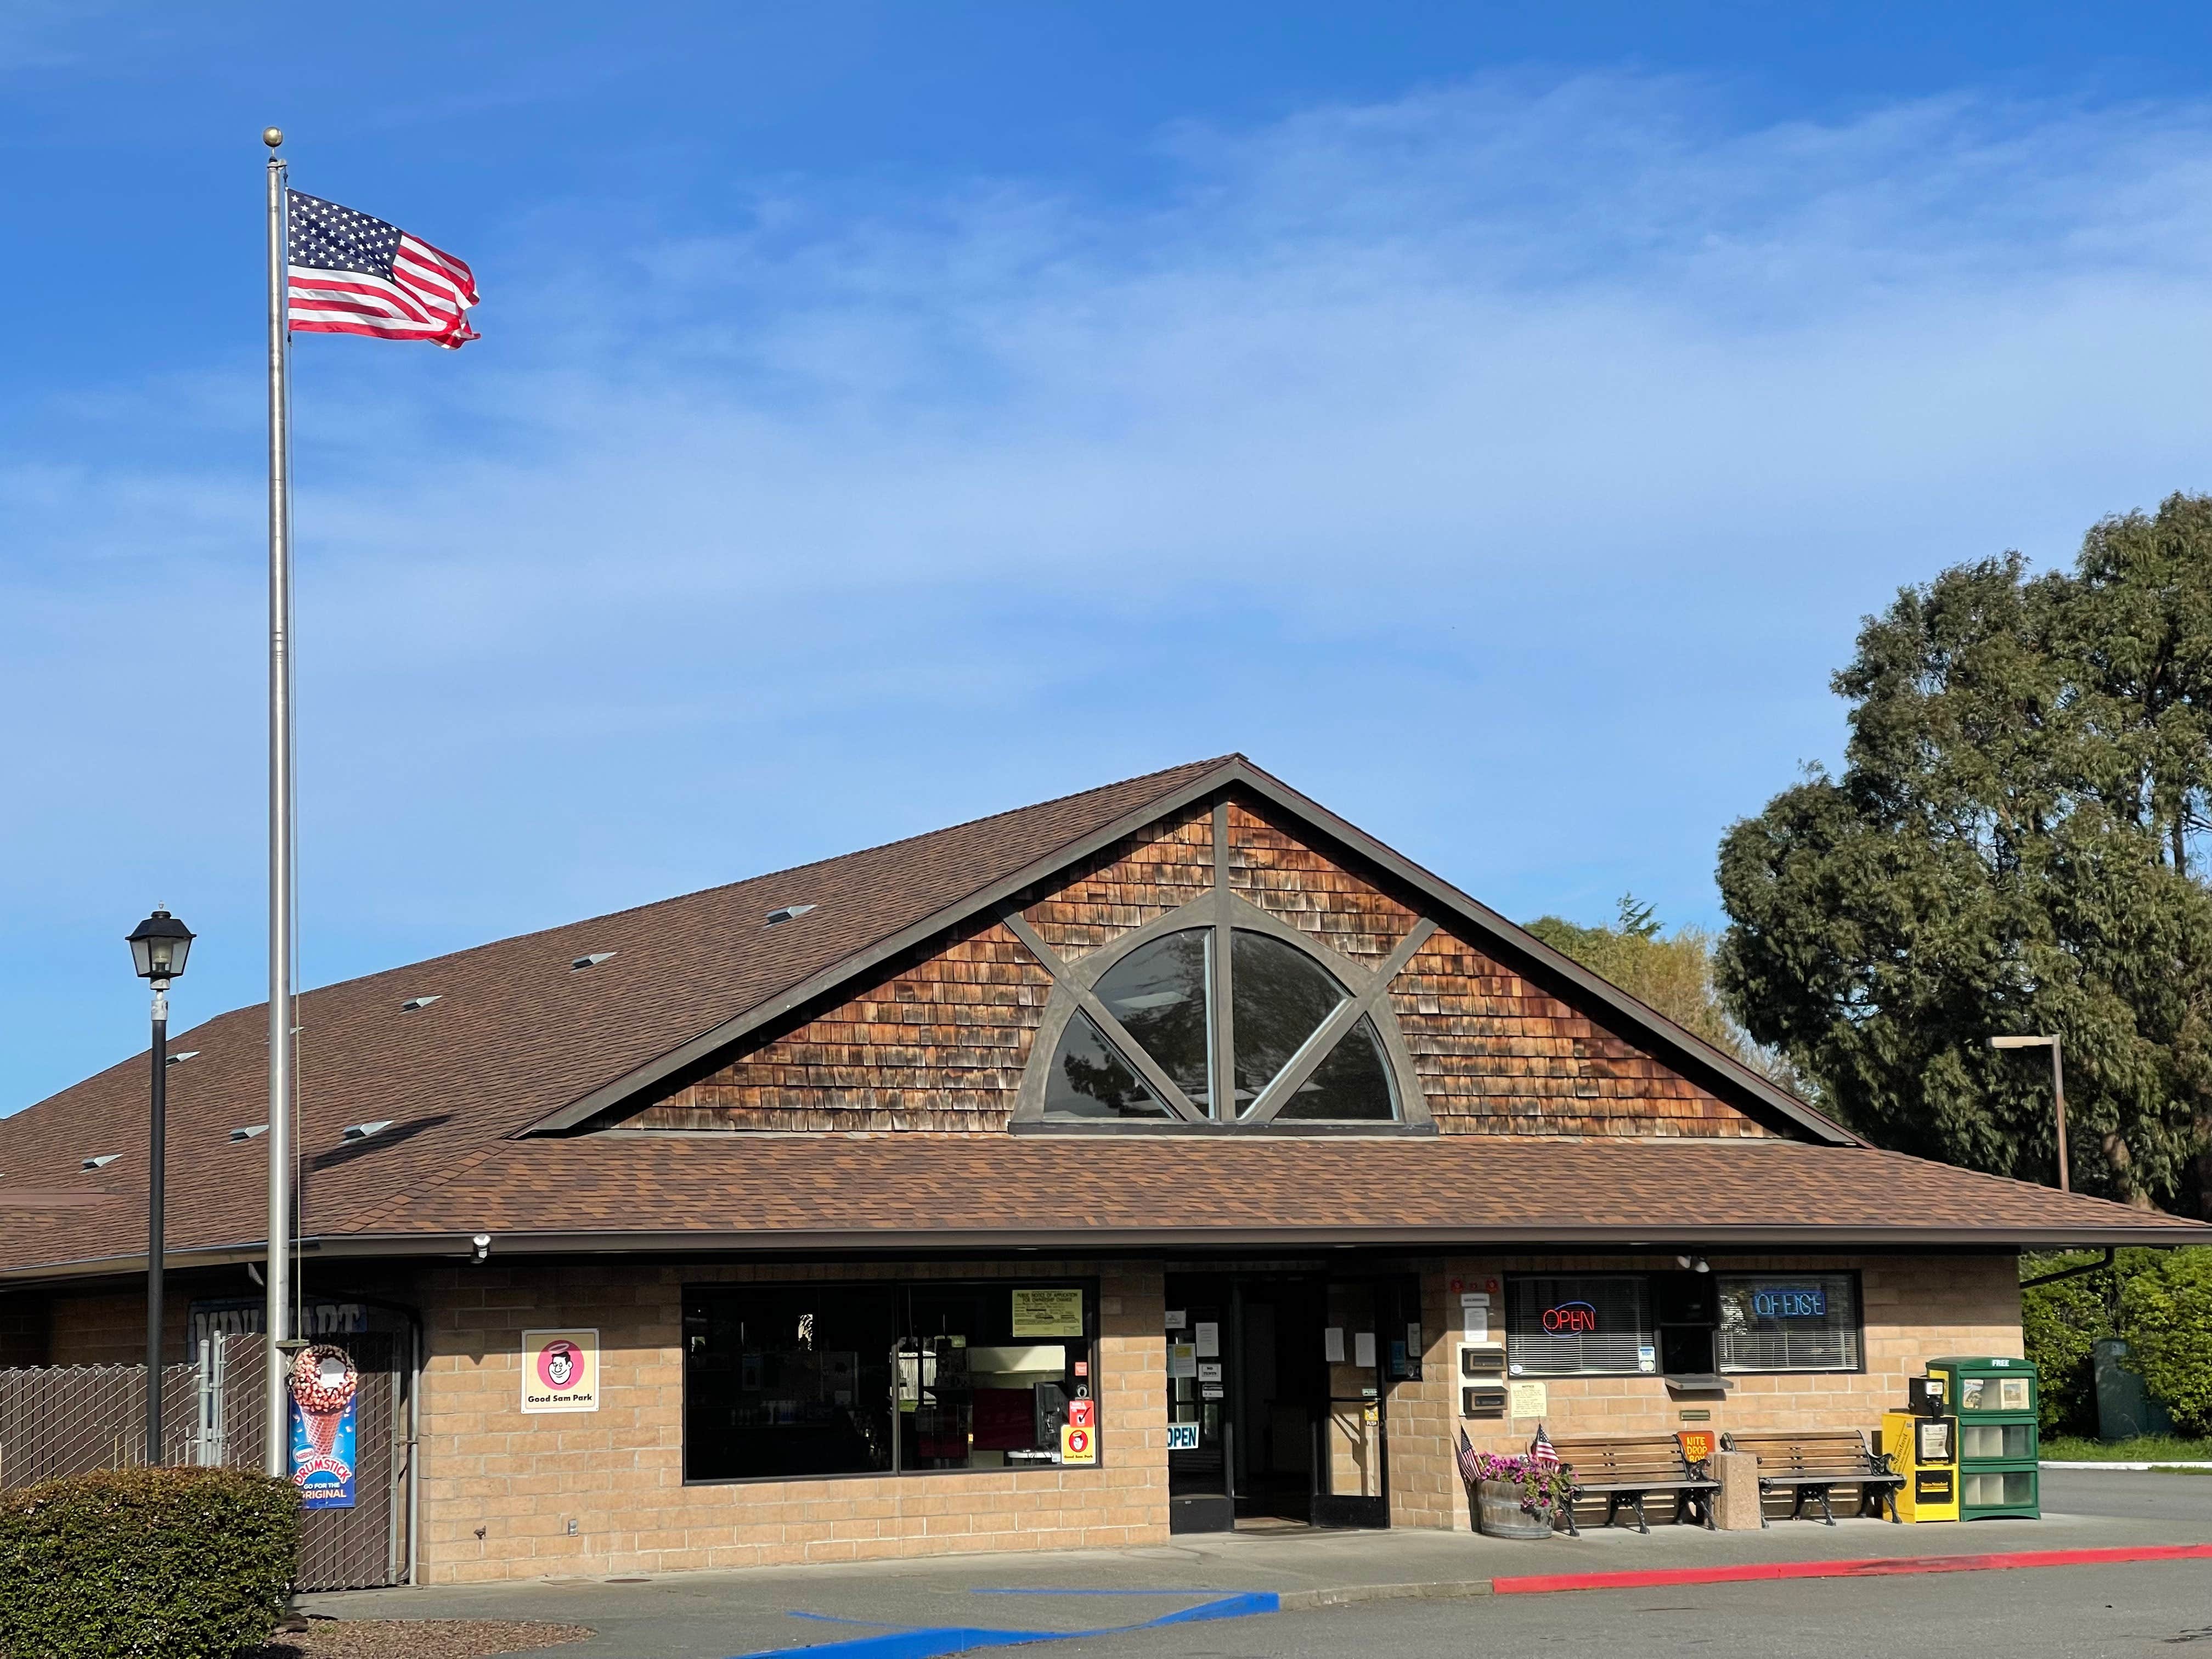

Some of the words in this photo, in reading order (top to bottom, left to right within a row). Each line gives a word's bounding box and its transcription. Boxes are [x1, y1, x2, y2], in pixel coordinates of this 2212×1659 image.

[1543, 1309, 1595, 1330] OPEN
[1686, 1436, 1706, 1446] NITE
[1686, 1446, 1708, 1455] DROP
[293, 1459, 351, 1485] DRUMSTICK
[301, 1489, 347, 1499] RIGINAL
